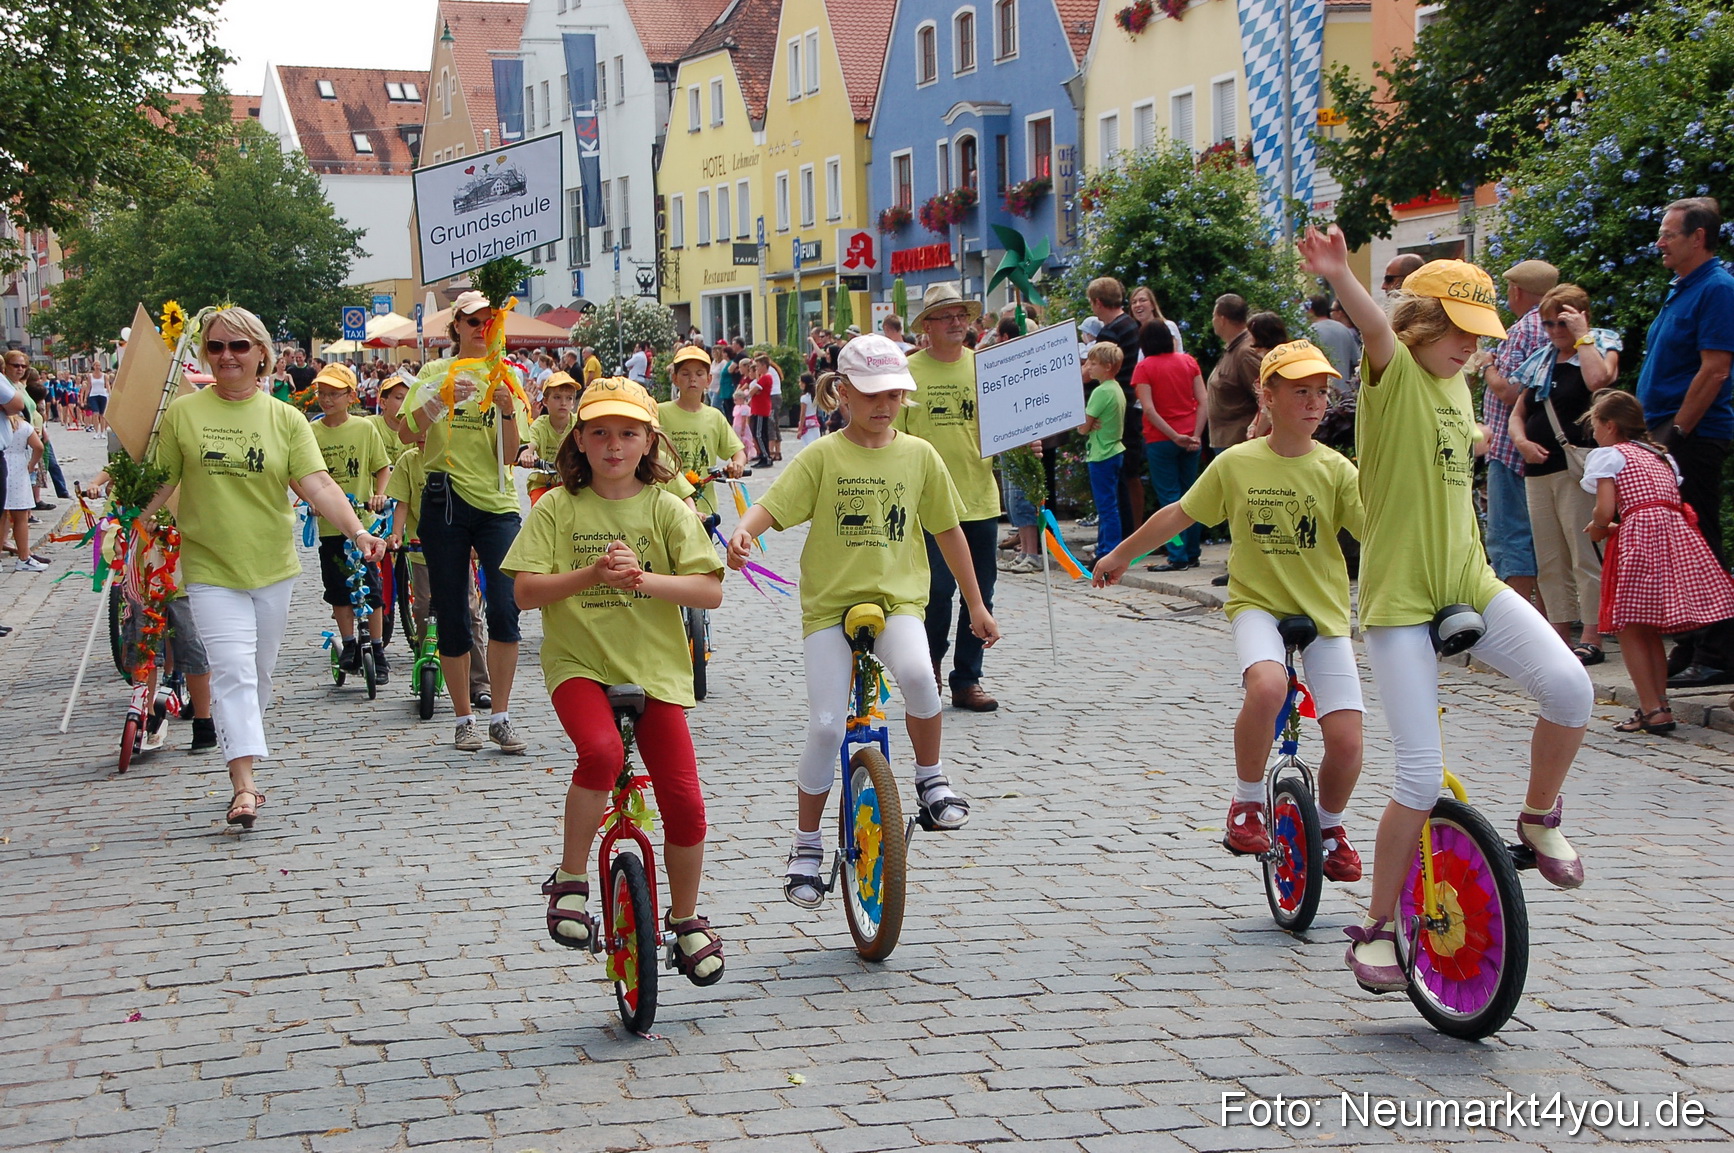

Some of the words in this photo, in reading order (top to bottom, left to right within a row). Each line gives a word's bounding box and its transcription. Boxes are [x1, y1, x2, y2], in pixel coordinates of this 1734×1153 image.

[702, 154, 727, 179] HOTEL
[732, 149, 760, 171] Lehmeier
[430, 197, 550, 245] Grundschule
[450, 229, 537, 268] Holzheim
[735, 256, 758, 264] TAIFU
[889, 241, 952, 274] APOTHEKE
[703, 269, 737, 285] Restaurant
[1448, 281, 1470, 298] GS
[345, 330, 365, 339] TAXI
[984, 346, 1035, 370] Naturwissenschaft
[1035, 343, 1046, 353] und
[1047, 336, 1068, 350] Technik
[982, 363, 1048, 394] BesTec-Preis
[1049, 353, 1074, 372] 2013
[1013, 402, 1022, 413] 1.
[1025, 392, 1050, 410] Preis
[202, 426, 243, 434] Grundschule
[993, 424, 1033, 443] Grundschulen
[1034, 420, 1044, 429] der
[1045, 411, 1072, 426] Oberpfalz
[203, 434, 233, 442] Holzheim
[208, 469, 247, 478] Umweltschule
[837, 476, 886, 486] Grundschule
[837, 487, 875, 497] Holzheim
[1247, 487, 1297, 497] Grundschule
[1247, 498, 1284, 507] Holzheim
[572, 532, 627, 541] Grundschule
[573, 544, 606, 554] Holzhei
[581, 600, 633, 609] Umweltschule
